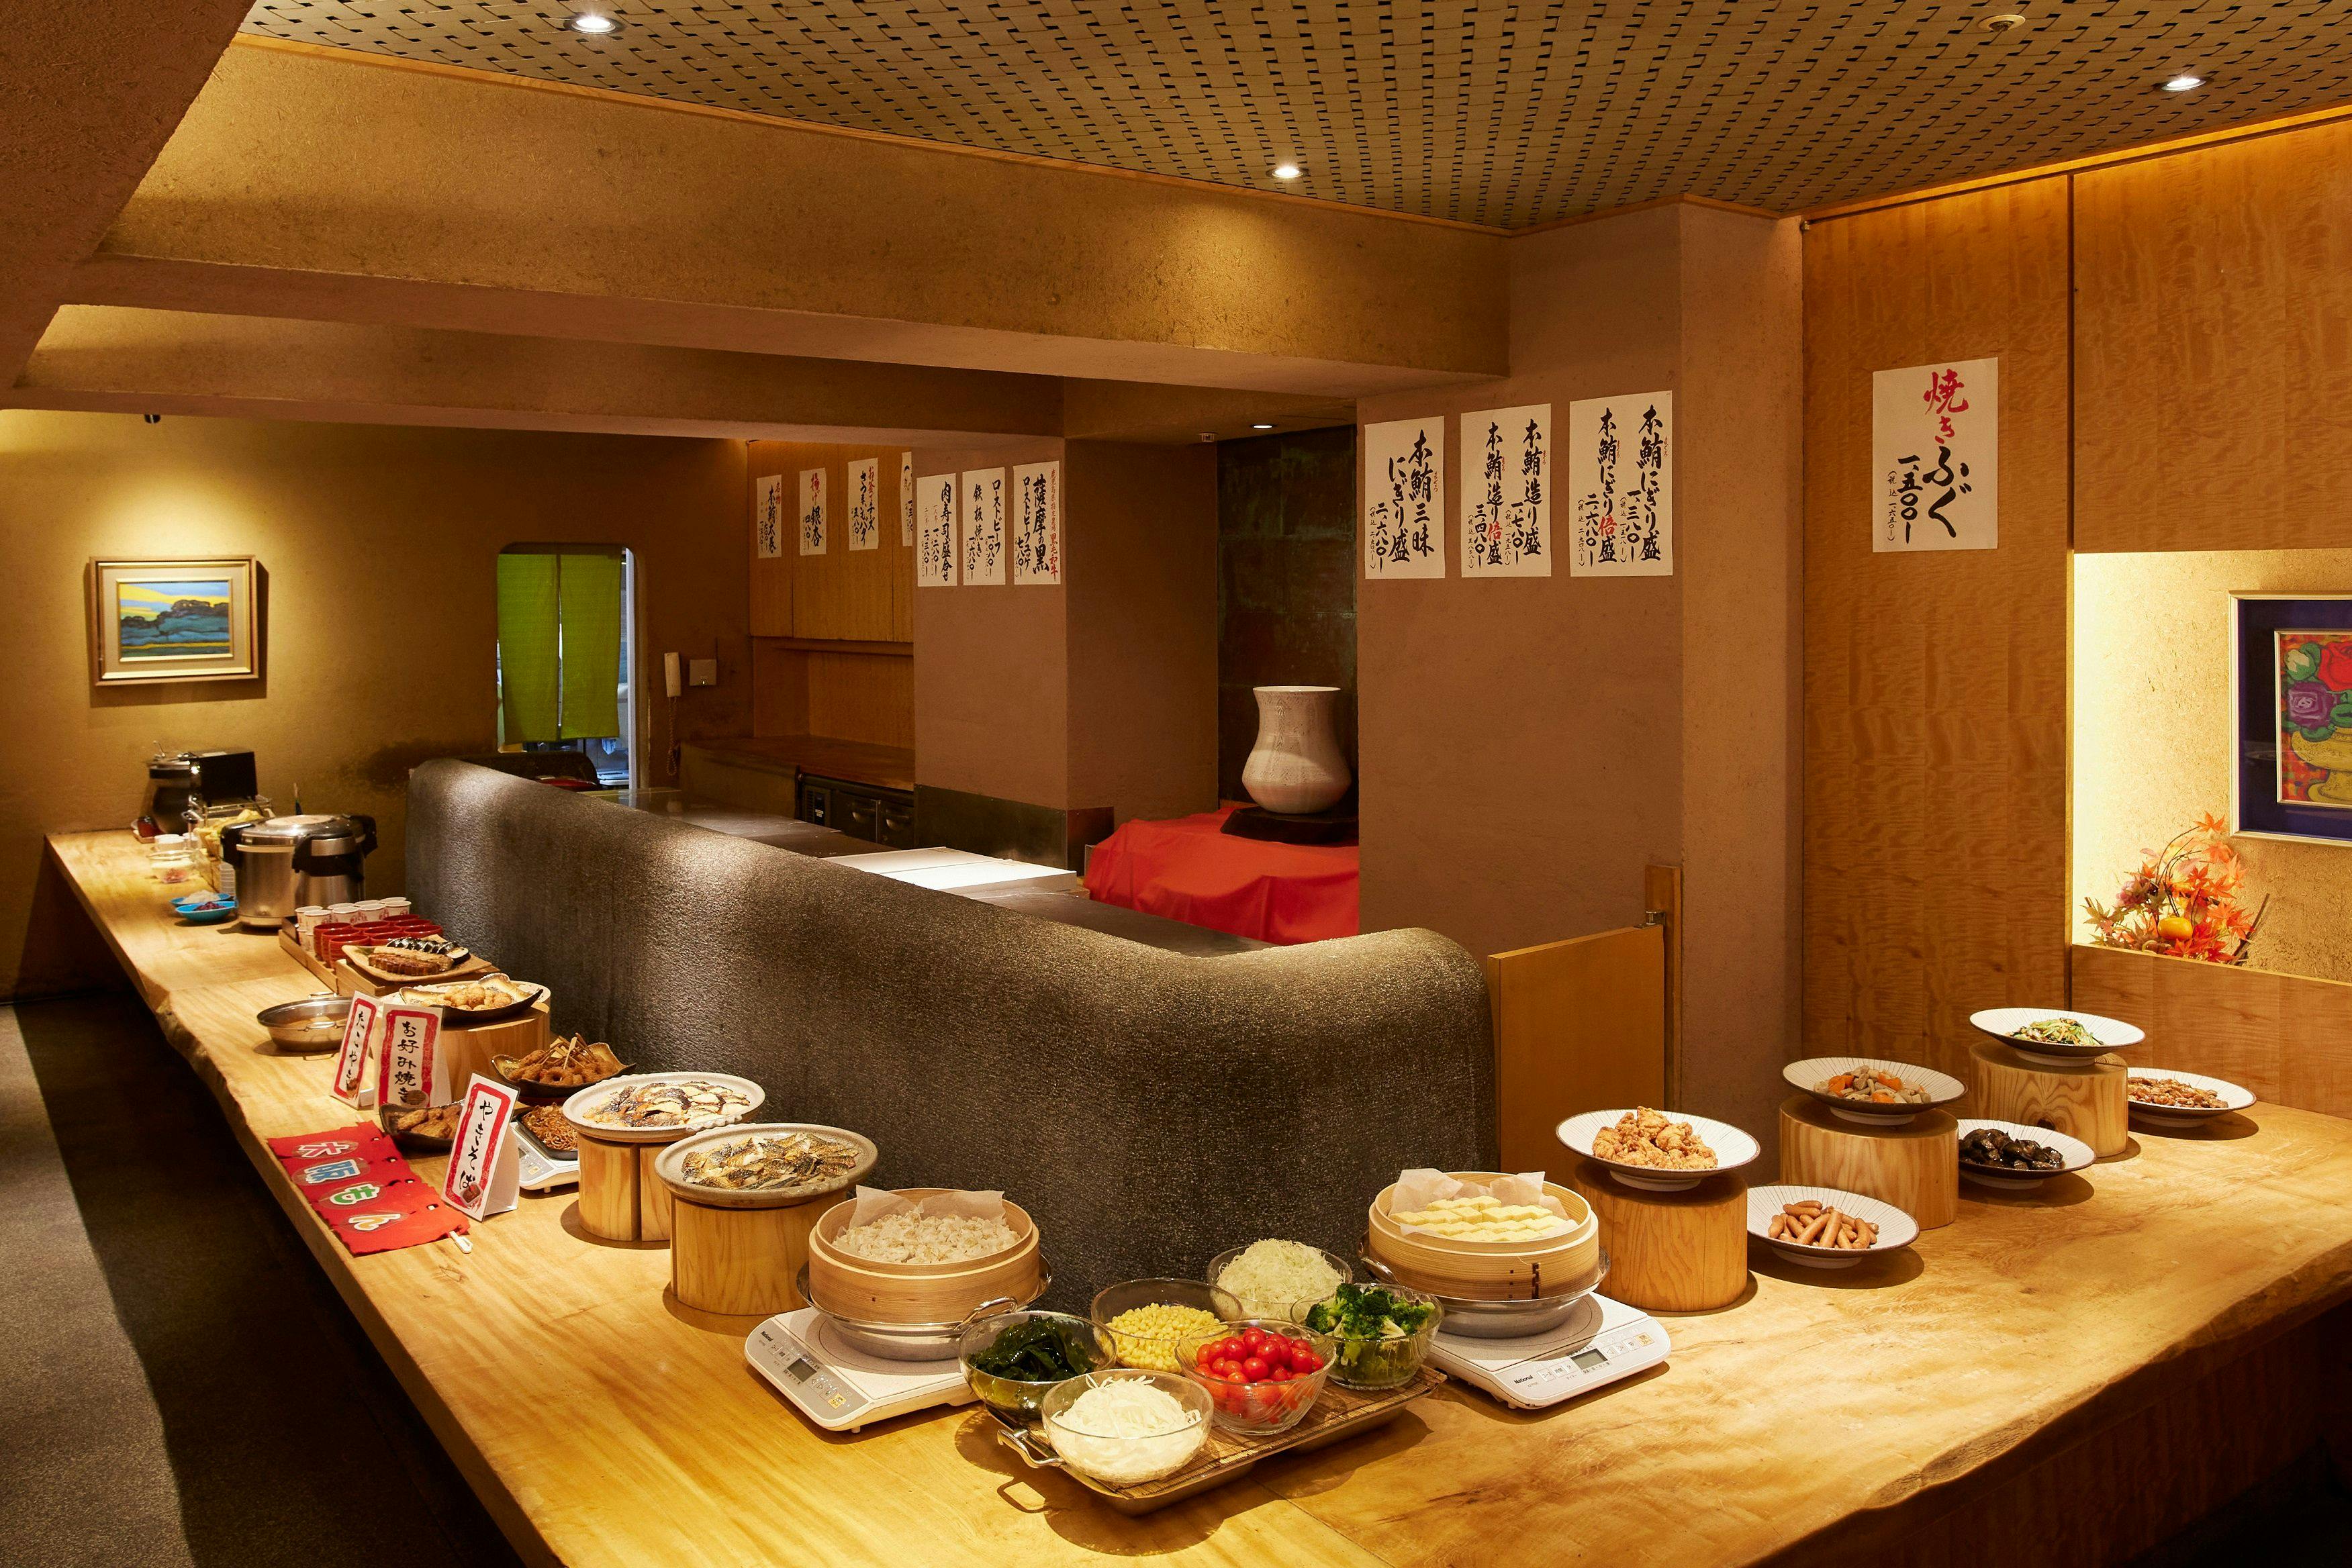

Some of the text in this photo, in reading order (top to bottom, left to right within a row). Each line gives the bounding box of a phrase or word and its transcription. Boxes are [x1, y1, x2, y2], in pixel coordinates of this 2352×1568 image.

[1484, 422, 1504, 565] 本鮪造り倍盛
[1521, 418, 1542, 555] 本鮪造り盛
[1598, 407, 1617, 562] 本鮪にぎり倍盛
[1636, 404, 1663, 561] 本鮪にぎり盛
[1922, 369, 1972, 538] 焼きふぐ
[810, 473, 822, 547] 揚げ銀杏
[973, 483, 983, 557] 鉄板焼き
[992, 479, 1002, 554] ローストビーフ
[1023, 476, 1031, 571] ローストビーフユッケ
[1033, 473, 1049, 575] 薩摩の黒
[1388, 456, 1410, 562] にぎり盛
[459, 1099, 493, 1191] やきそば
[1513, 1374, 1534, 1384] National
